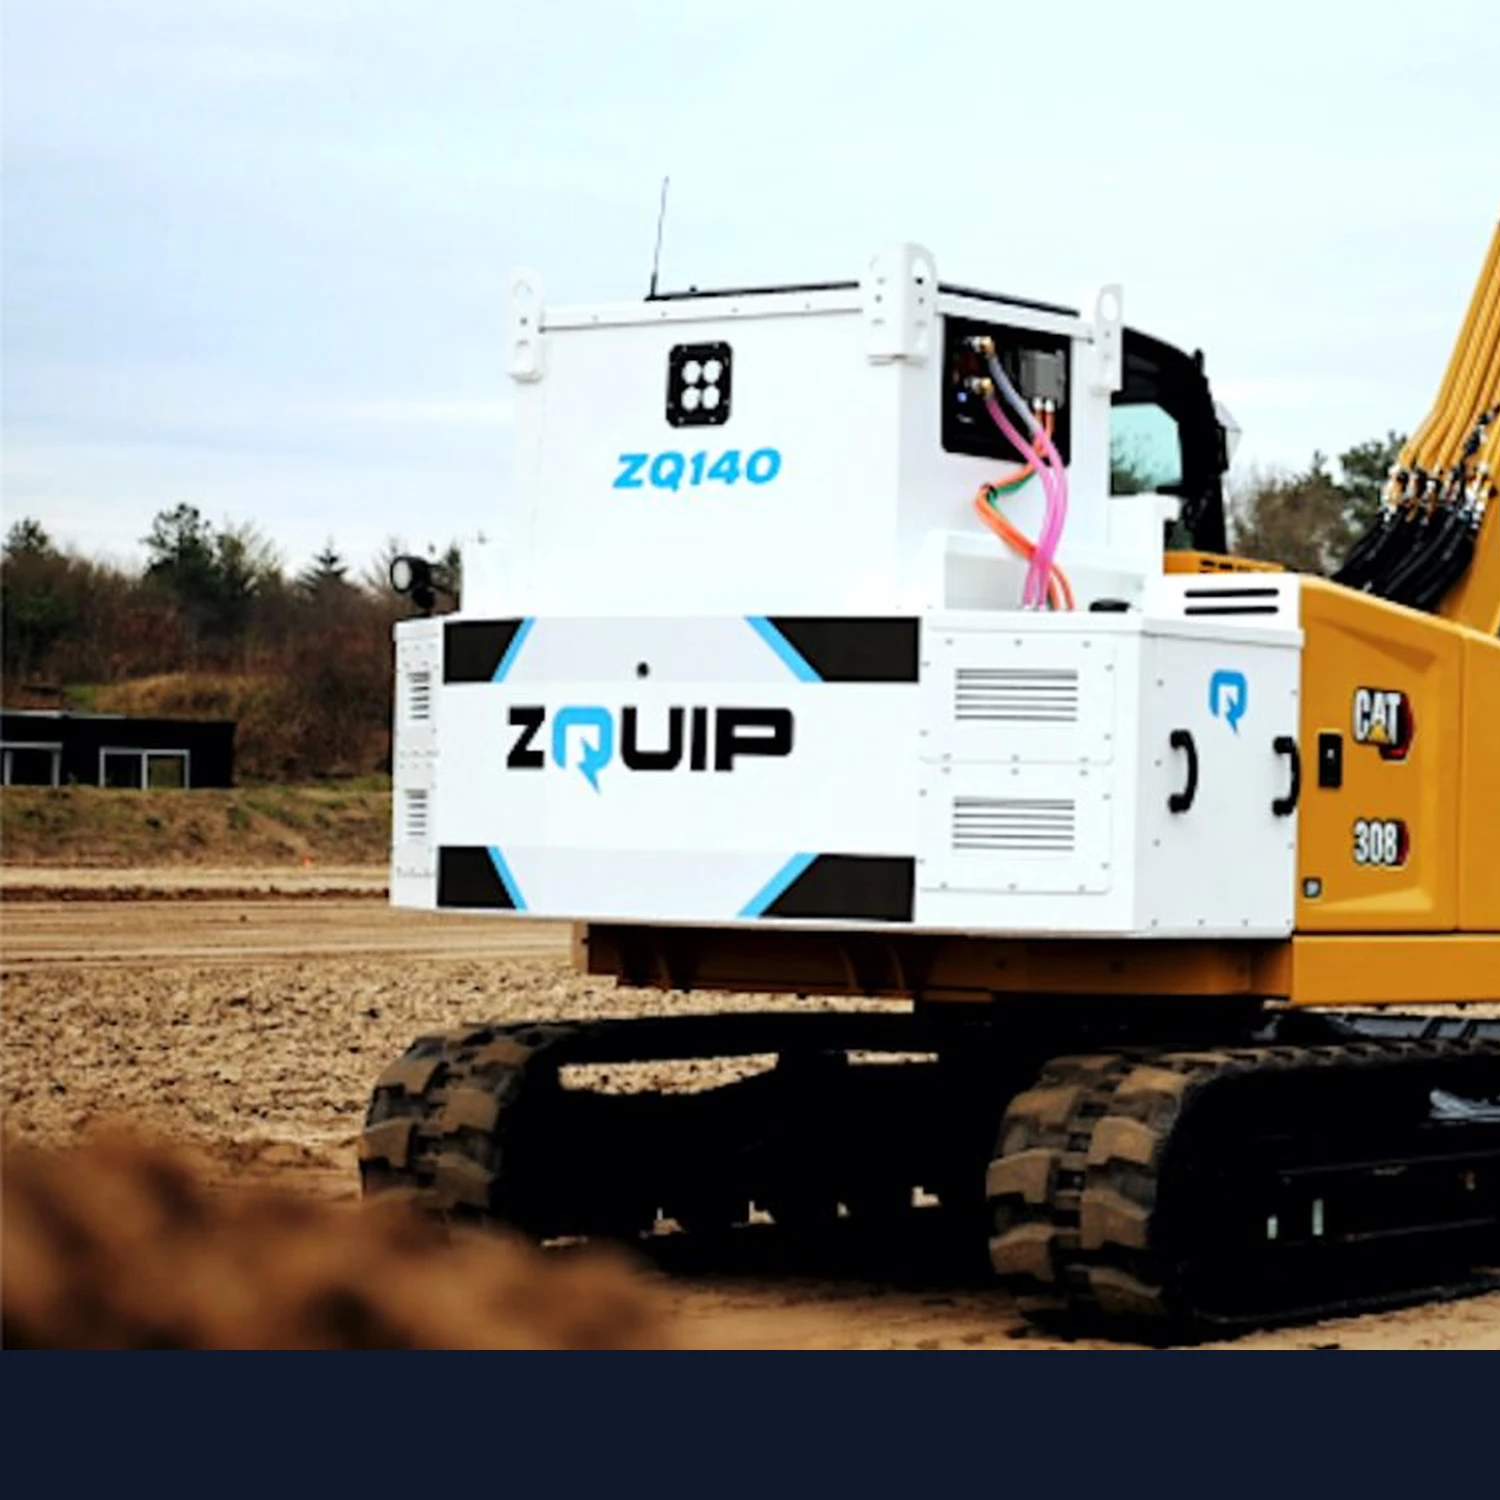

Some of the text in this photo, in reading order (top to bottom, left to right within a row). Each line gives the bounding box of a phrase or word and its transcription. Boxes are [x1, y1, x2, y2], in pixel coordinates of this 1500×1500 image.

[613, 448, 781, 492] ZQ140
[1354, 688, 1401, 745] CAT
[506, 706, 795, 793] ZQUIP
[1354, 821, 1398, 864] 308
